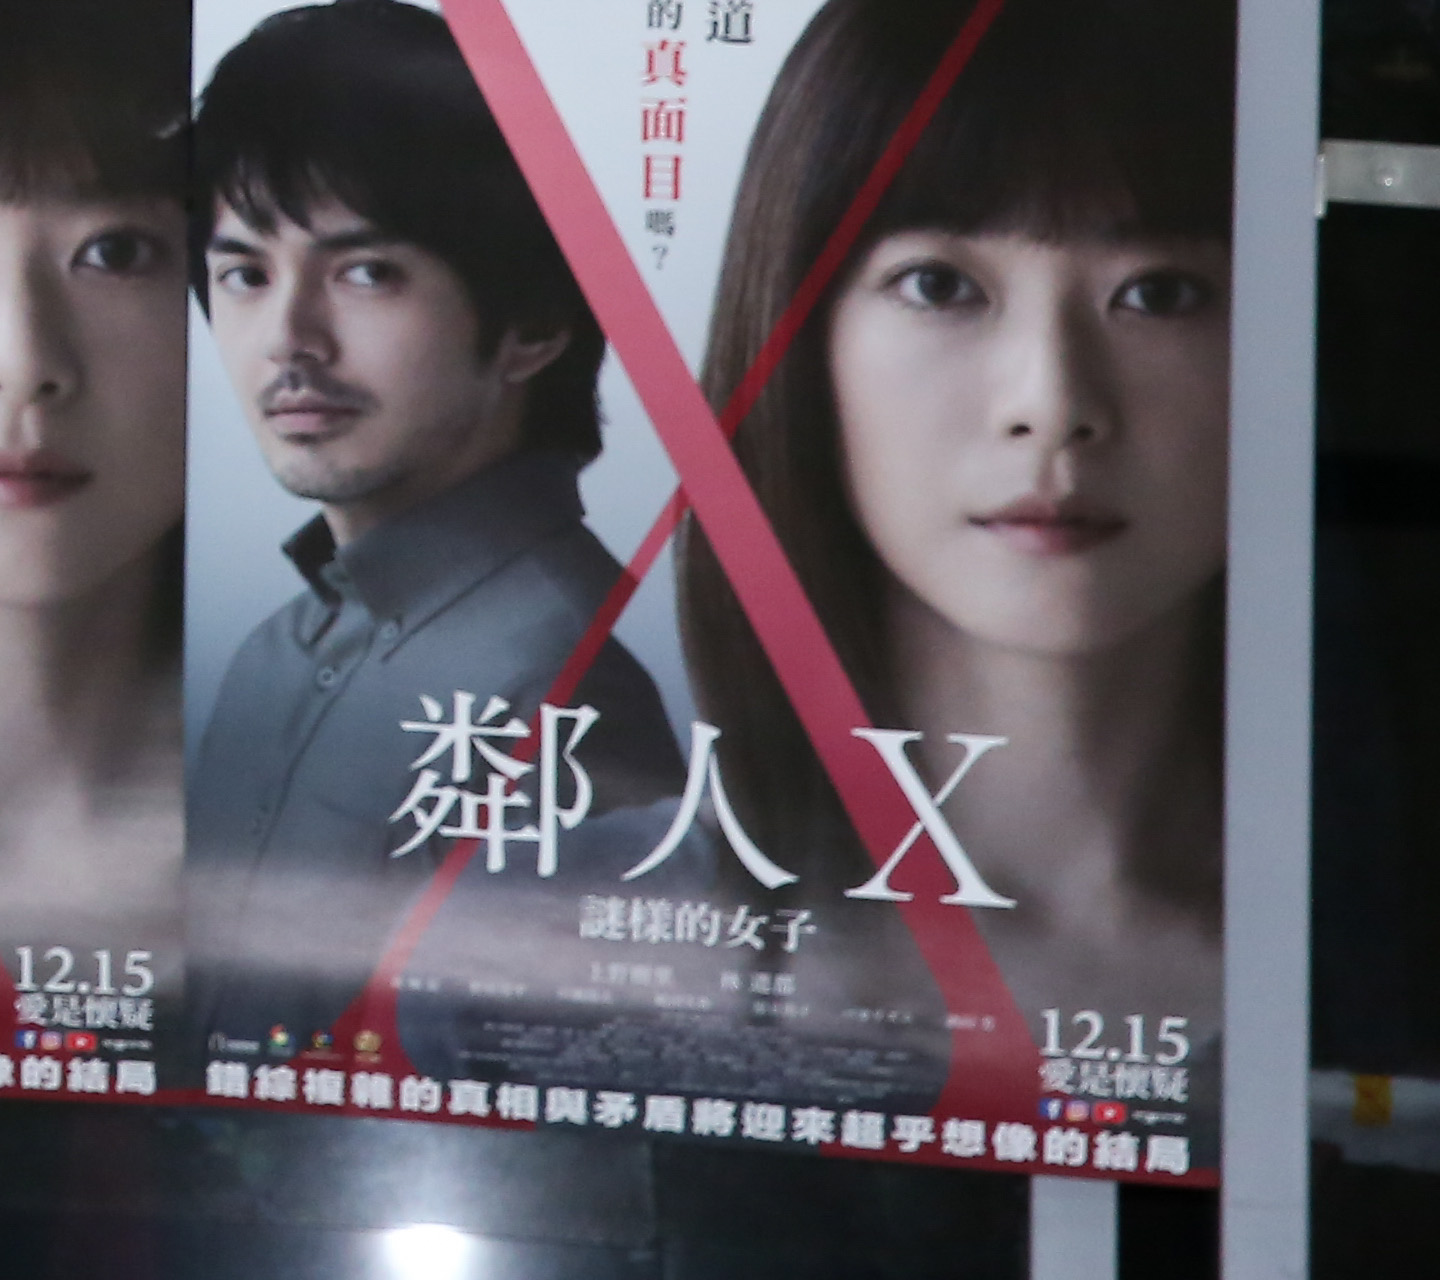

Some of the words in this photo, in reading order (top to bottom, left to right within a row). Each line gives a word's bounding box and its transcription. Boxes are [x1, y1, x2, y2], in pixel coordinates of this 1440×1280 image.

[578, 891, 816, 955] 謎樣的女子
[14, 944, 155, 997] 12.15
[1040, 1006, 1191, 1065] 12.15
